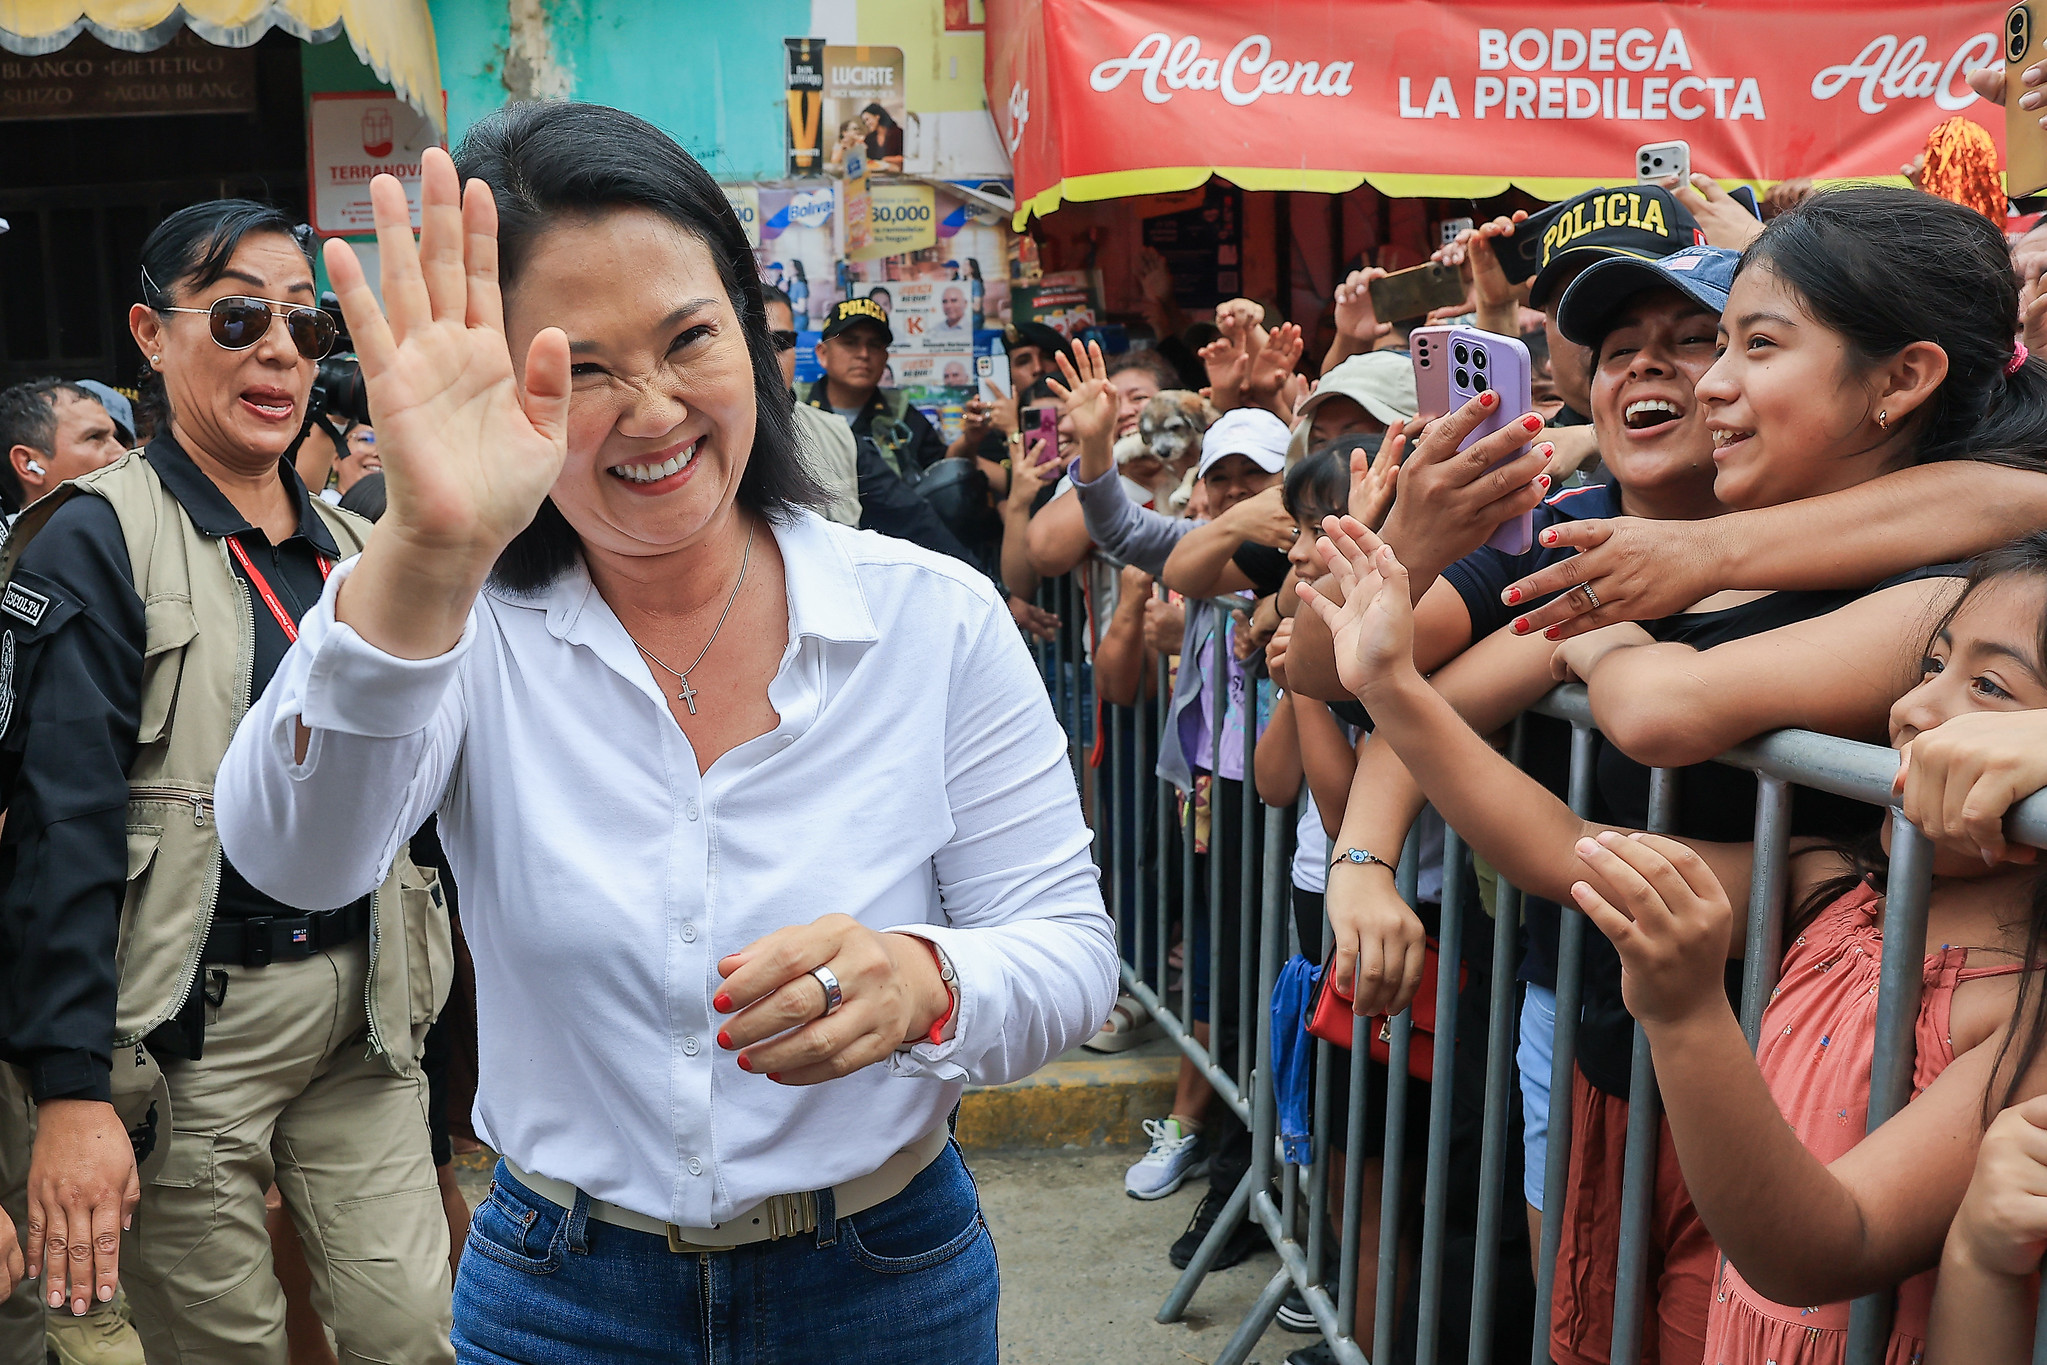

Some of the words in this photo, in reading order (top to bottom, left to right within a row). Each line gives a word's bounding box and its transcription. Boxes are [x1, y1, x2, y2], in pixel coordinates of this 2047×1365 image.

[1478, 28, 1692, 72] BODEGA
[2, 60, 93, 79] BLANCO
[110, 56, 224, 76] DIETETICO
[831, 66, 894, 86] LUCIRTE
[1089, 32, 1355, 106] AlaCena
[1811, 32, 2005, 114] AlaC
[4, 87, 73, 104] SUIZO
[112, 83, 170, 101] AGUA
[1399, 77, 1461, 119] LA
[1473, 77, 1767, 120] PREDILECTA
[330, 164, 422, 180] TERRANOV
[872, 205, 930, 224] 30,000
[1542, 192, 1668, 268] POLICIA
[907, 317, 924, 335] K
[5, 590, 41, 617] ESCOLTA
